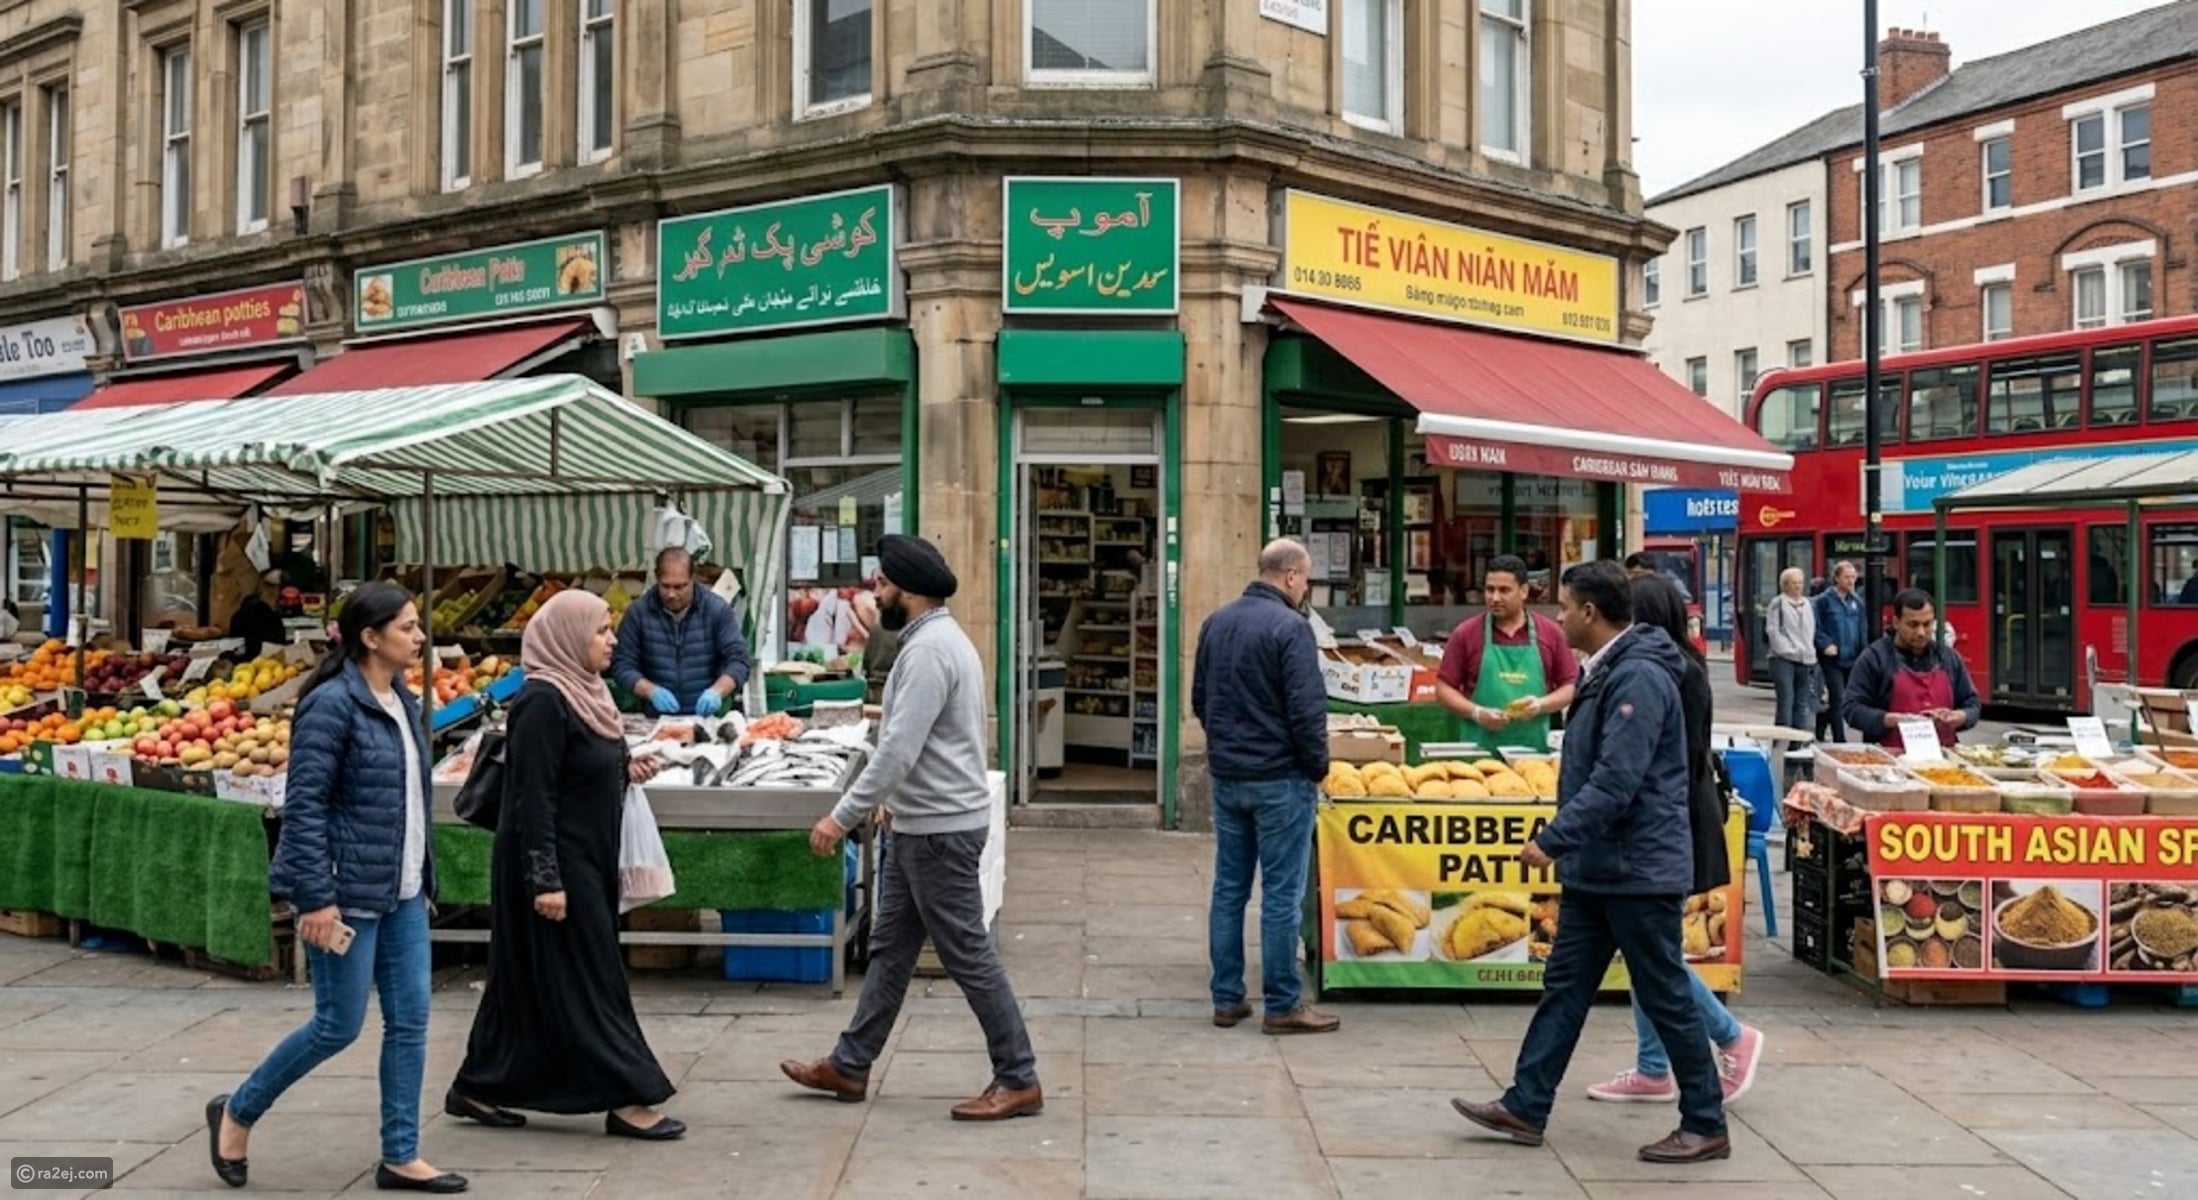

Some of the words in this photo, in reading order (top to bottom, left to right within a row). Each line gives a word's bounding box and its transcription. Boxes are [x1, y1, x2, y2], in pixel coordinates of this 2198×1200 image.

[21, 330, 55, 359] Too
[1347, 814, 1550, 845] CARIBBEA
[1878, 822, 2013, 863] SOUTH
[2023, 825, 2146, 865] ASIAN
